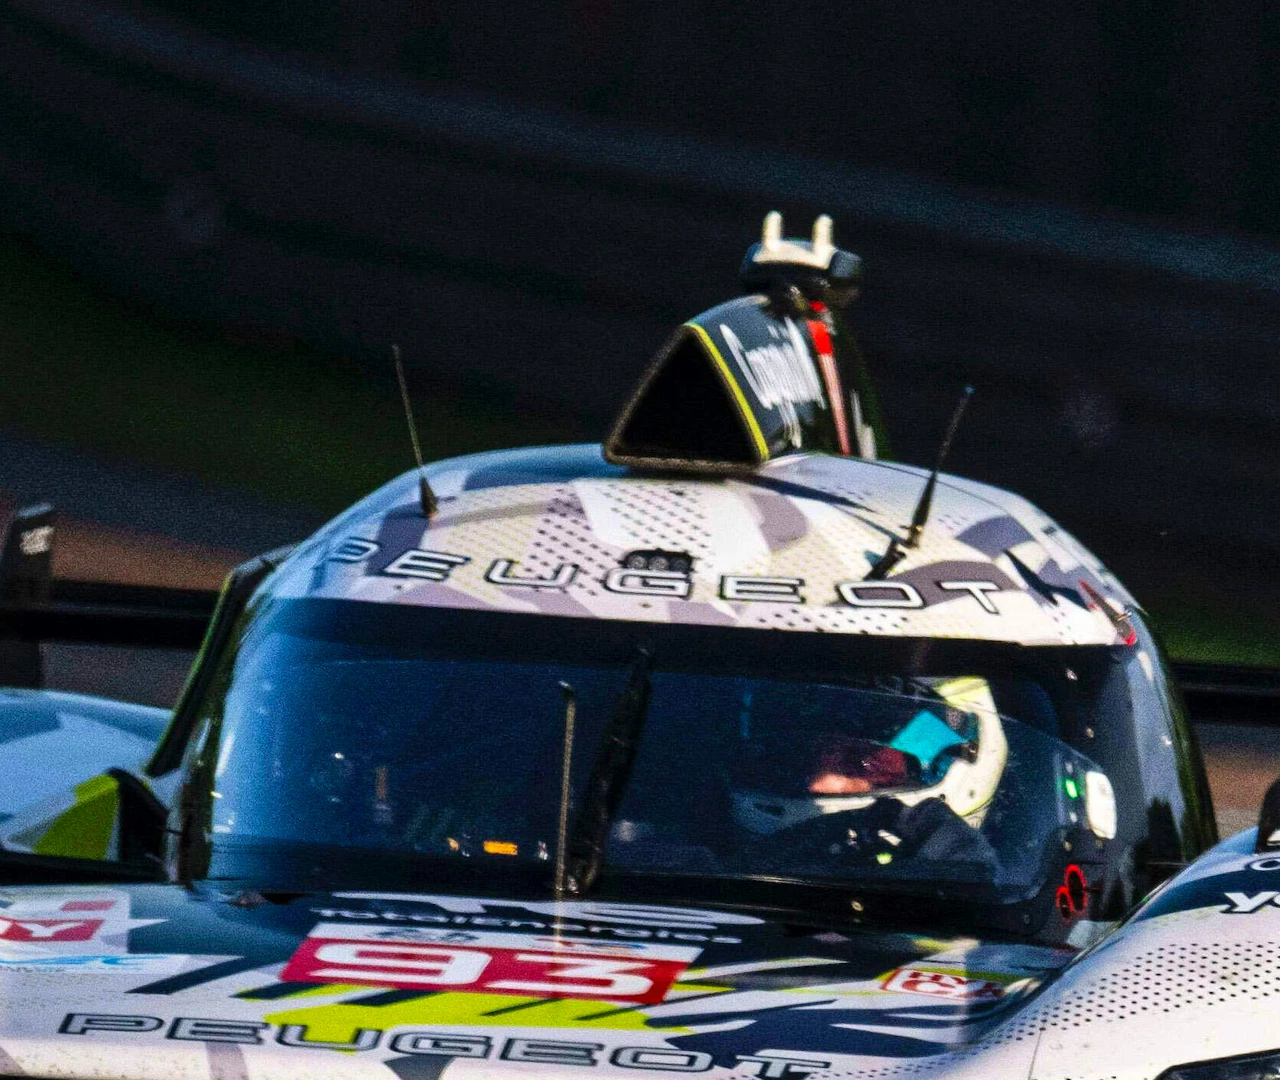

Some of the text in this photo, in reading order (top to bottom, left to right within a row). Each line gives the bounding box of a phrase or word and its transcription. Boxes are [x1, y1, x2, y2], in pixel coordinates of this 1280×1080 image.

[326, 535, 1007, 615] PEUGEOT
[309, 907, 743, 944] TotalEnergies
[309, 941, 658, 997] 93
[57, 1013, 831, 1079] PEUGEOT
